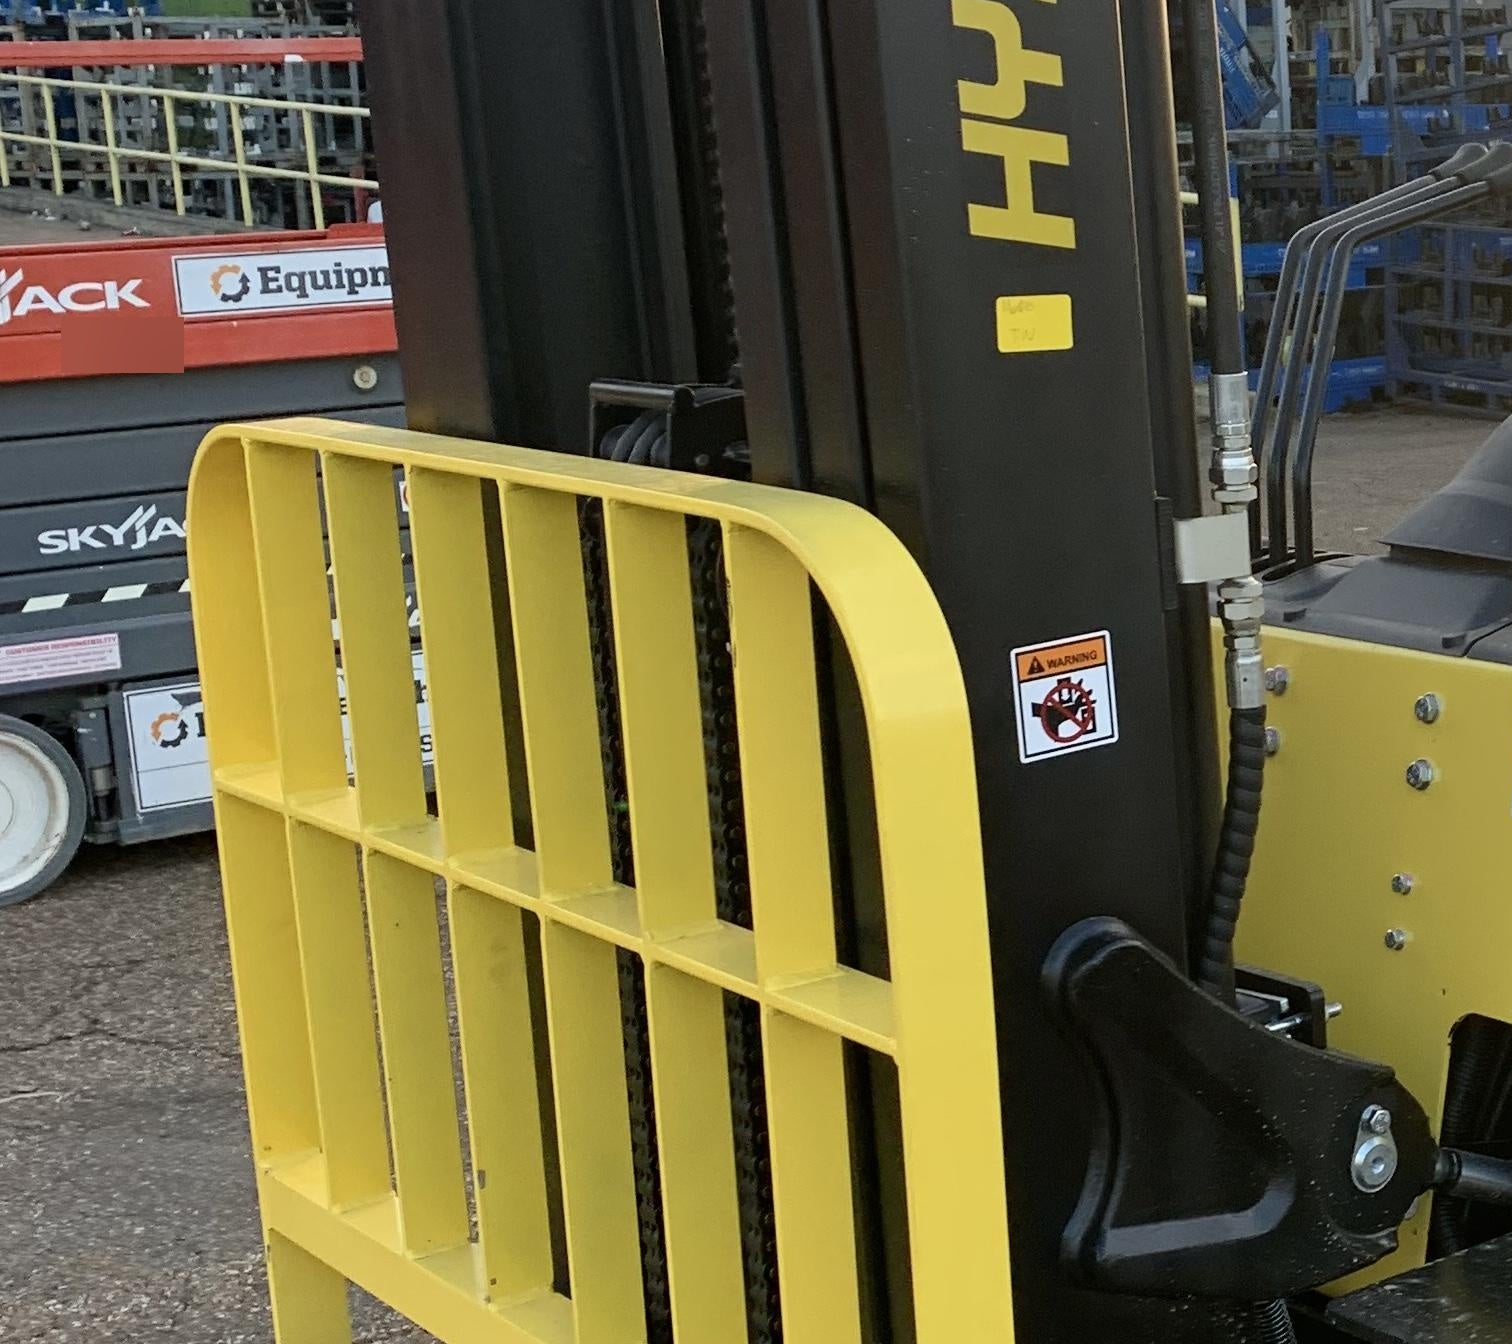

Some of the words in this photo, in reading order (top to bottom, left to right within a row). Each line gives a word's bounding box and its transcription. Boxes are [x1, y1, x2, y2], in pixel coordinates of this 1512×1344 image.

[0, 268, 151, 325] JACK
[37, 503, 188, 555] SKYJA
[1046, 650, 1098, 669] WARNING
